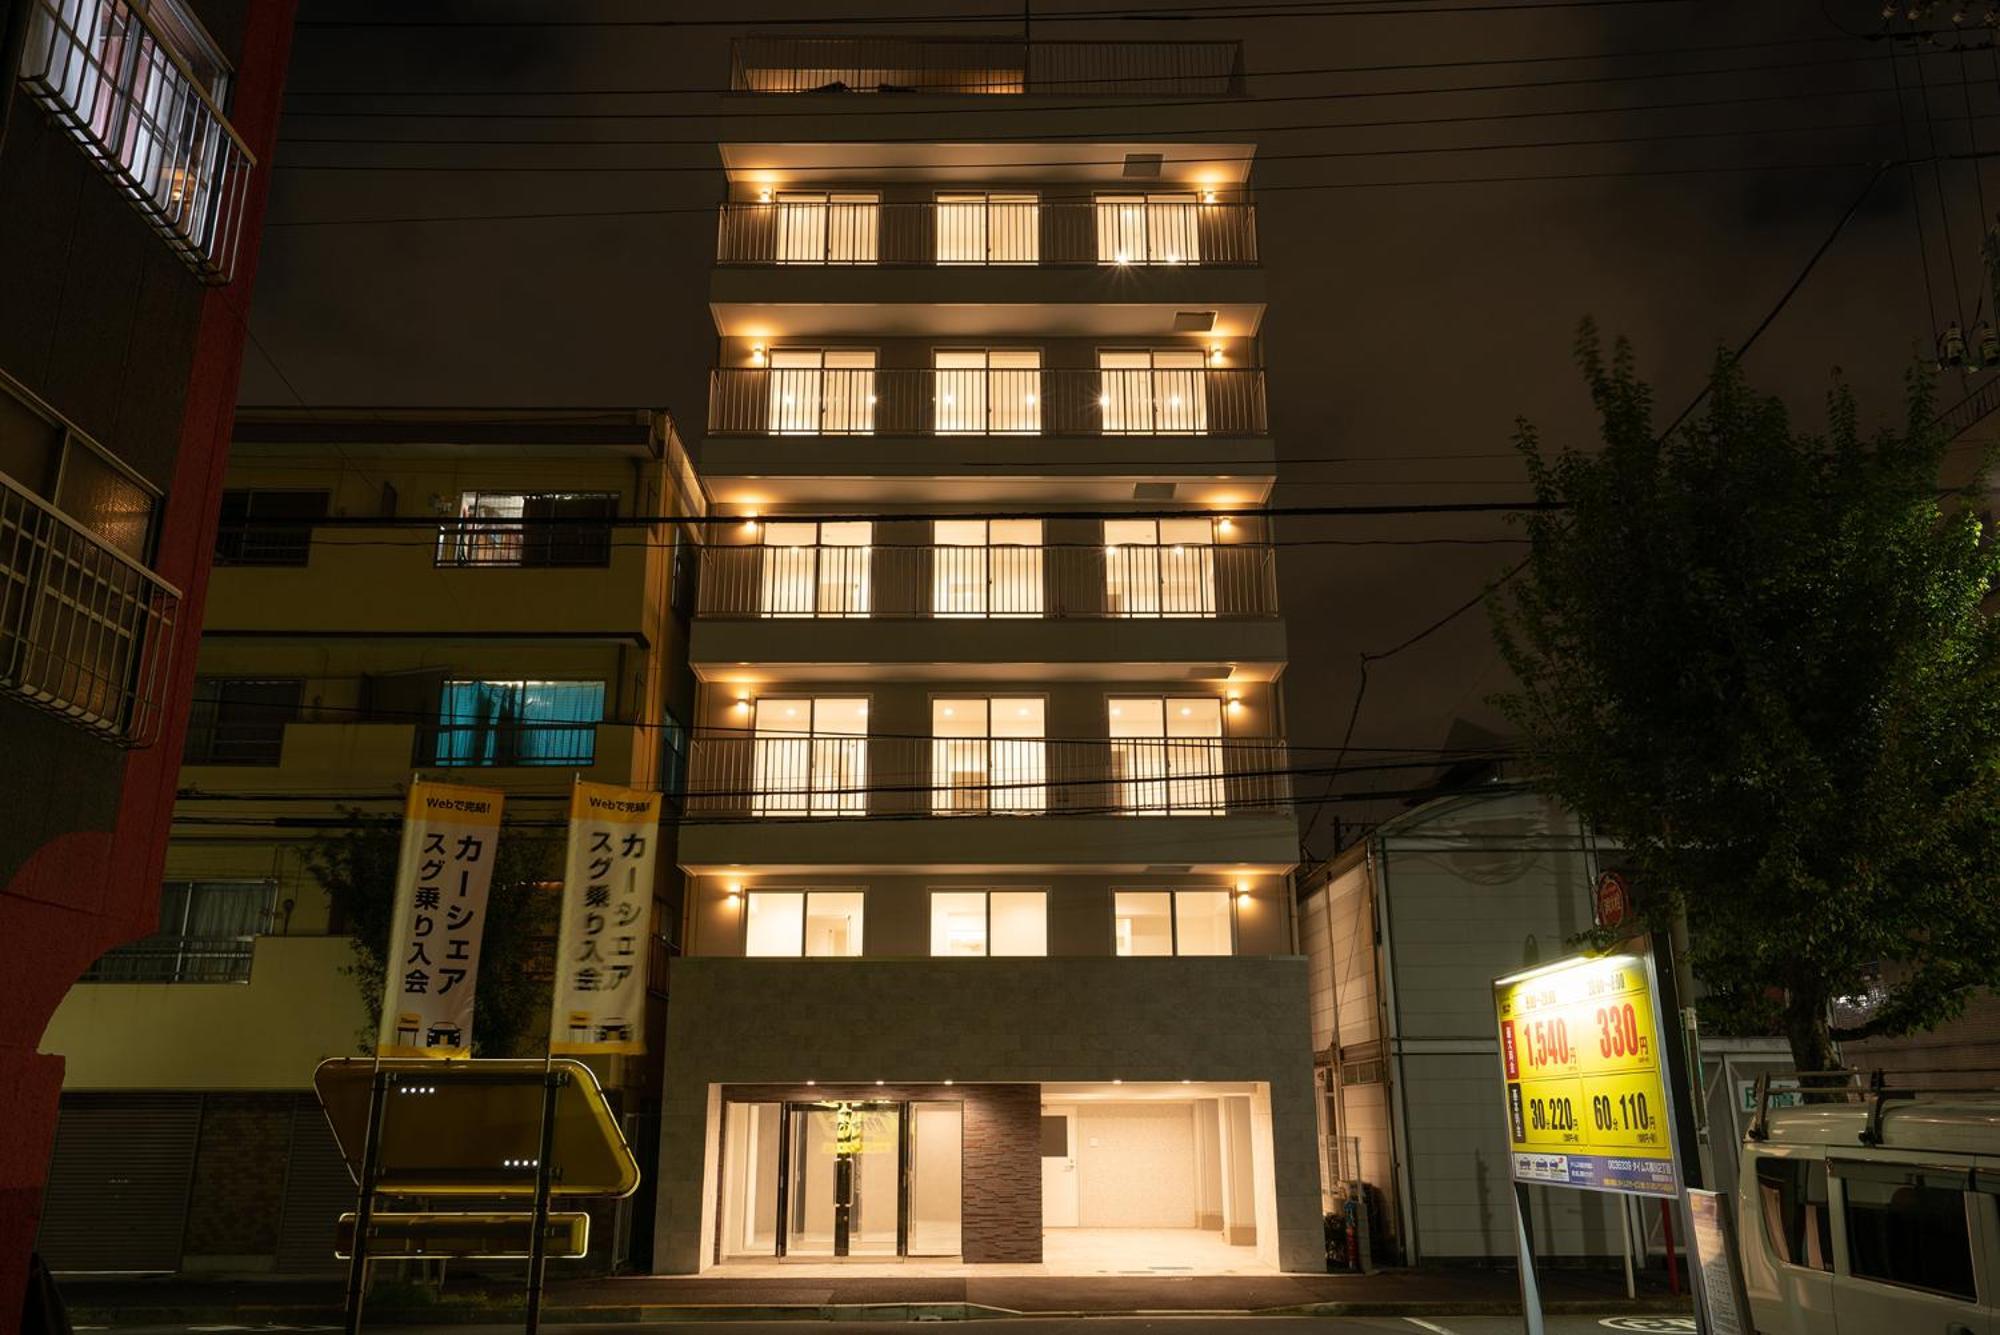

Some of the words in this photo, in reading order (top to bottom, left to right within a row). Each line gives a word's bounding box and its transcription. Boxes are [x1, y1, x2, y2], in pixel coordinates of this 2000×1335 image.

[426, 797, 491, 814] Webで完結!
[405, 833, 447, 995] スグ乗り入会
[438, 834, 483, 995] カーシェア
[574, 831, 613, 992] スグ乗り入会
[606, 832, 646, 992] カーシェア
